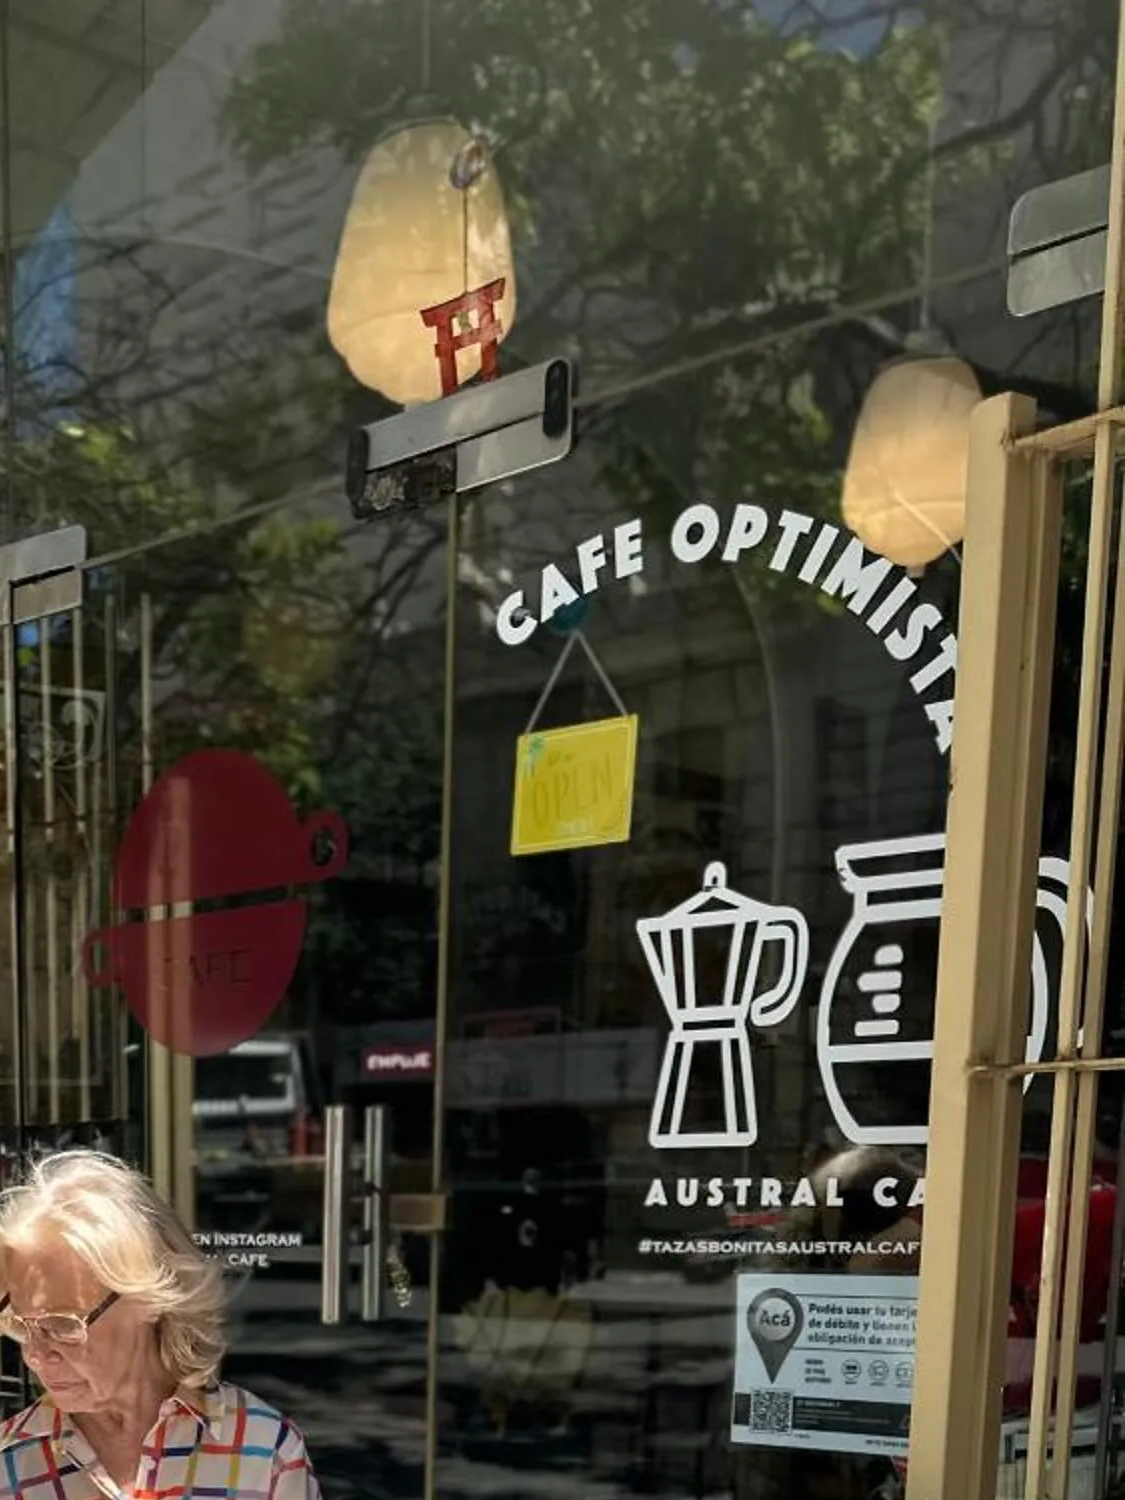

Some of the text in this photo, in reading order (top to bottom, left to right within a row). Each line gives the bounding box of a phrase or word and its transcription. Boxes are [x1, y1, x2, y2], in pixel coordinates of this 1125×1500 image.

[496, 503, 958, 756] CAFE OPTIMISTA
[644, 1177, 844, 1208] AUSTRAL
[214, 1231, 303, 1247] INSTAGRAM
[758, 1309, 791, 1327] Acá
[846, 1306, 872, 1316] usar
[808, 1318, 822, 1329] de
[861, 1320, 870, 1332] y
[807, 1330, 867, 1345] obligación
[868, 1333, 882, 1345] de
